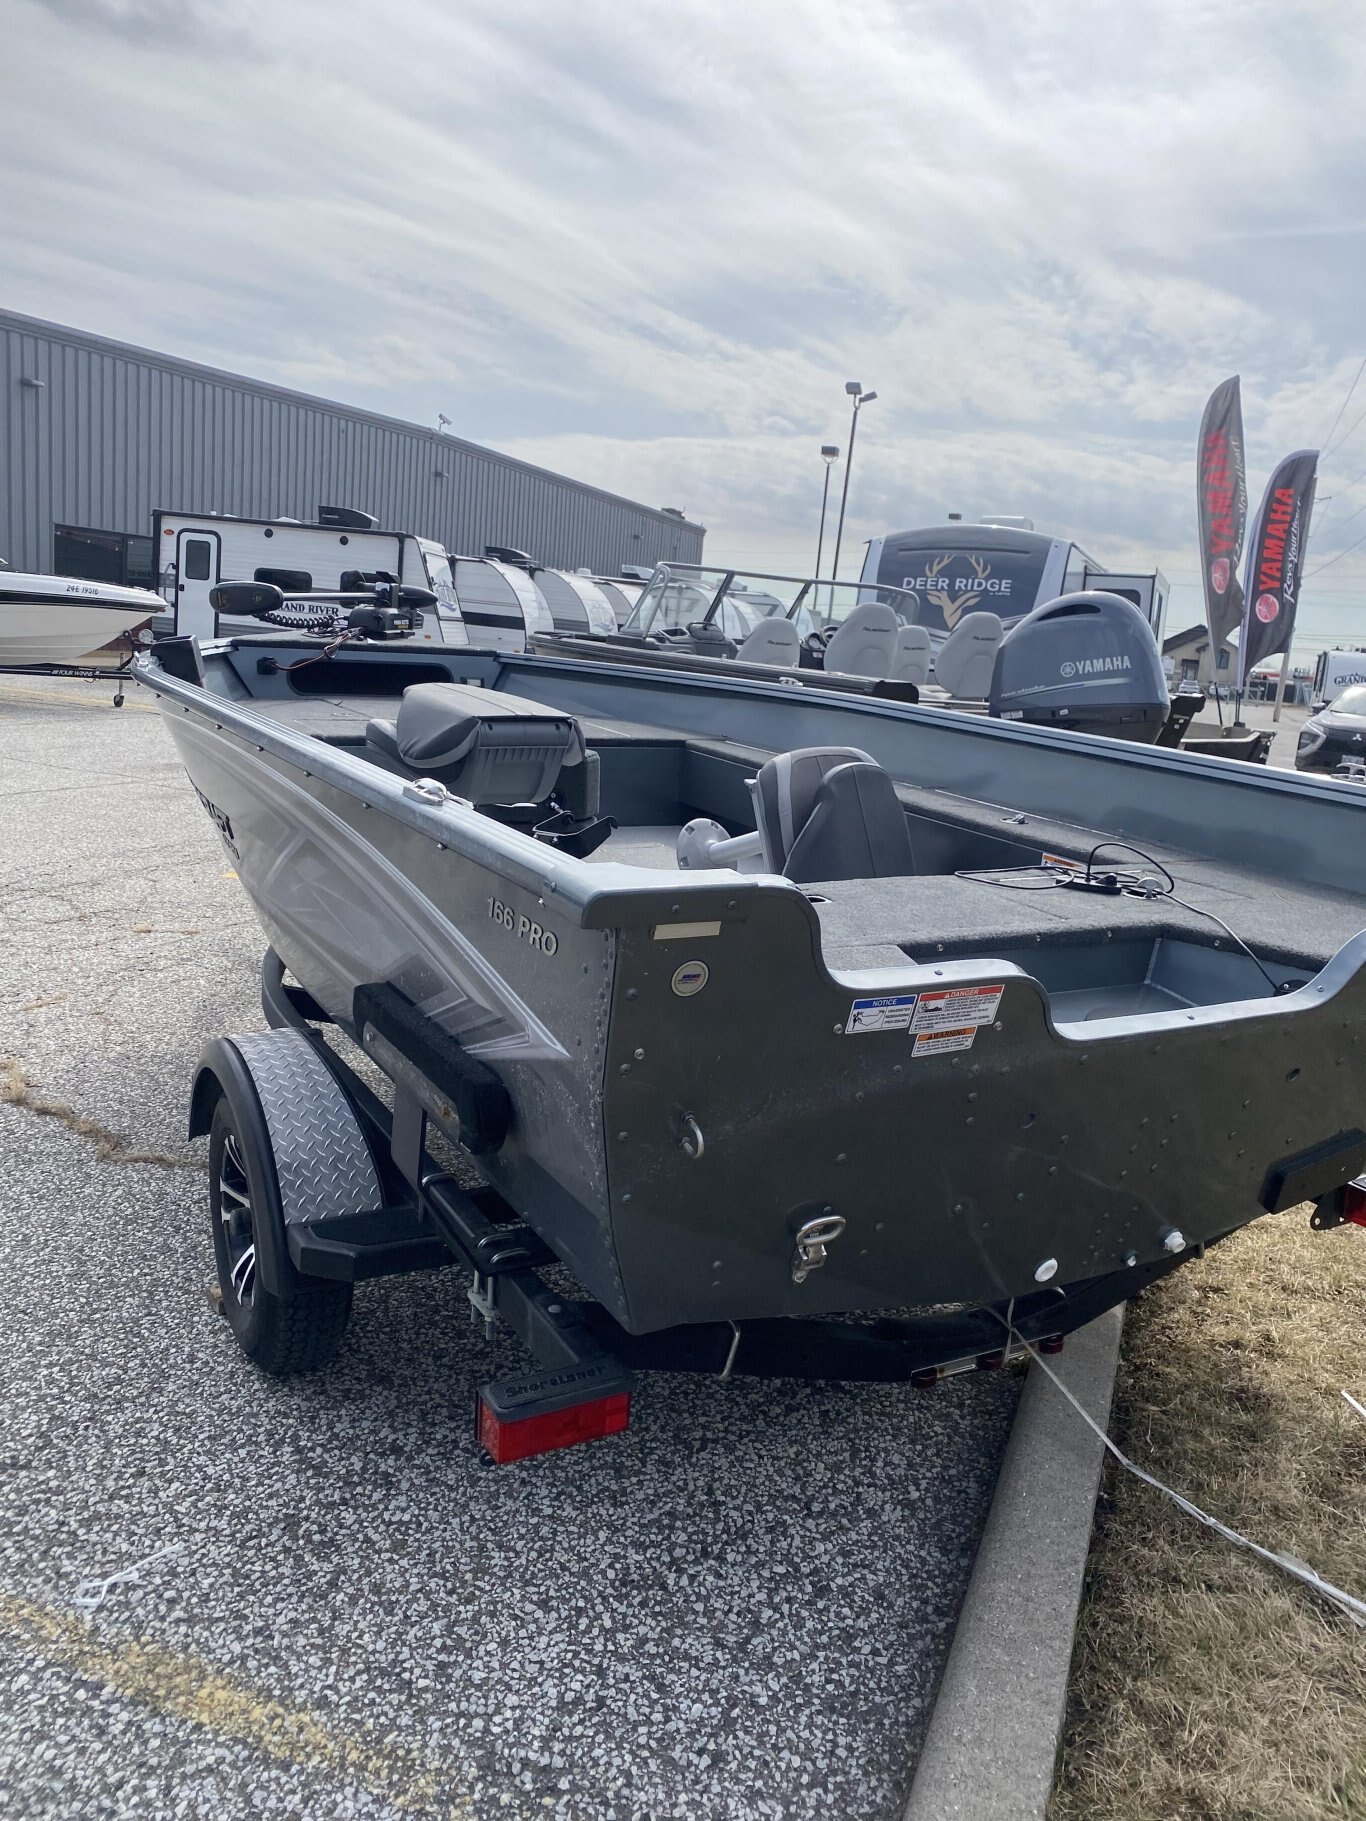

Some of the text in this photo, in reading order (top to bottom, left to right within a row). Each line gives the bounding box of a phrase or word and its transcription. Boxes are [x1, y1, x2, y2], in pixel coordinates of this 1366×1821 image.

[1259, 488, 1296, 591] YAMAHA
[1288, 534, 1298, 563] Your
[902, 577, 1013, 592] DEER RIDGE
[1283, 561, 1295, 604] Revs
[308, 605, 339, 617] RIVER
[1076, 655, 1132, 675] YAMAHA
[487, 896, 559, 957] 166 PRO
[950, 988, 980, 998] DANGER
[872, 998, 898, 1007] NOTICE
[934, 1028, 967, 1040] WARNING
